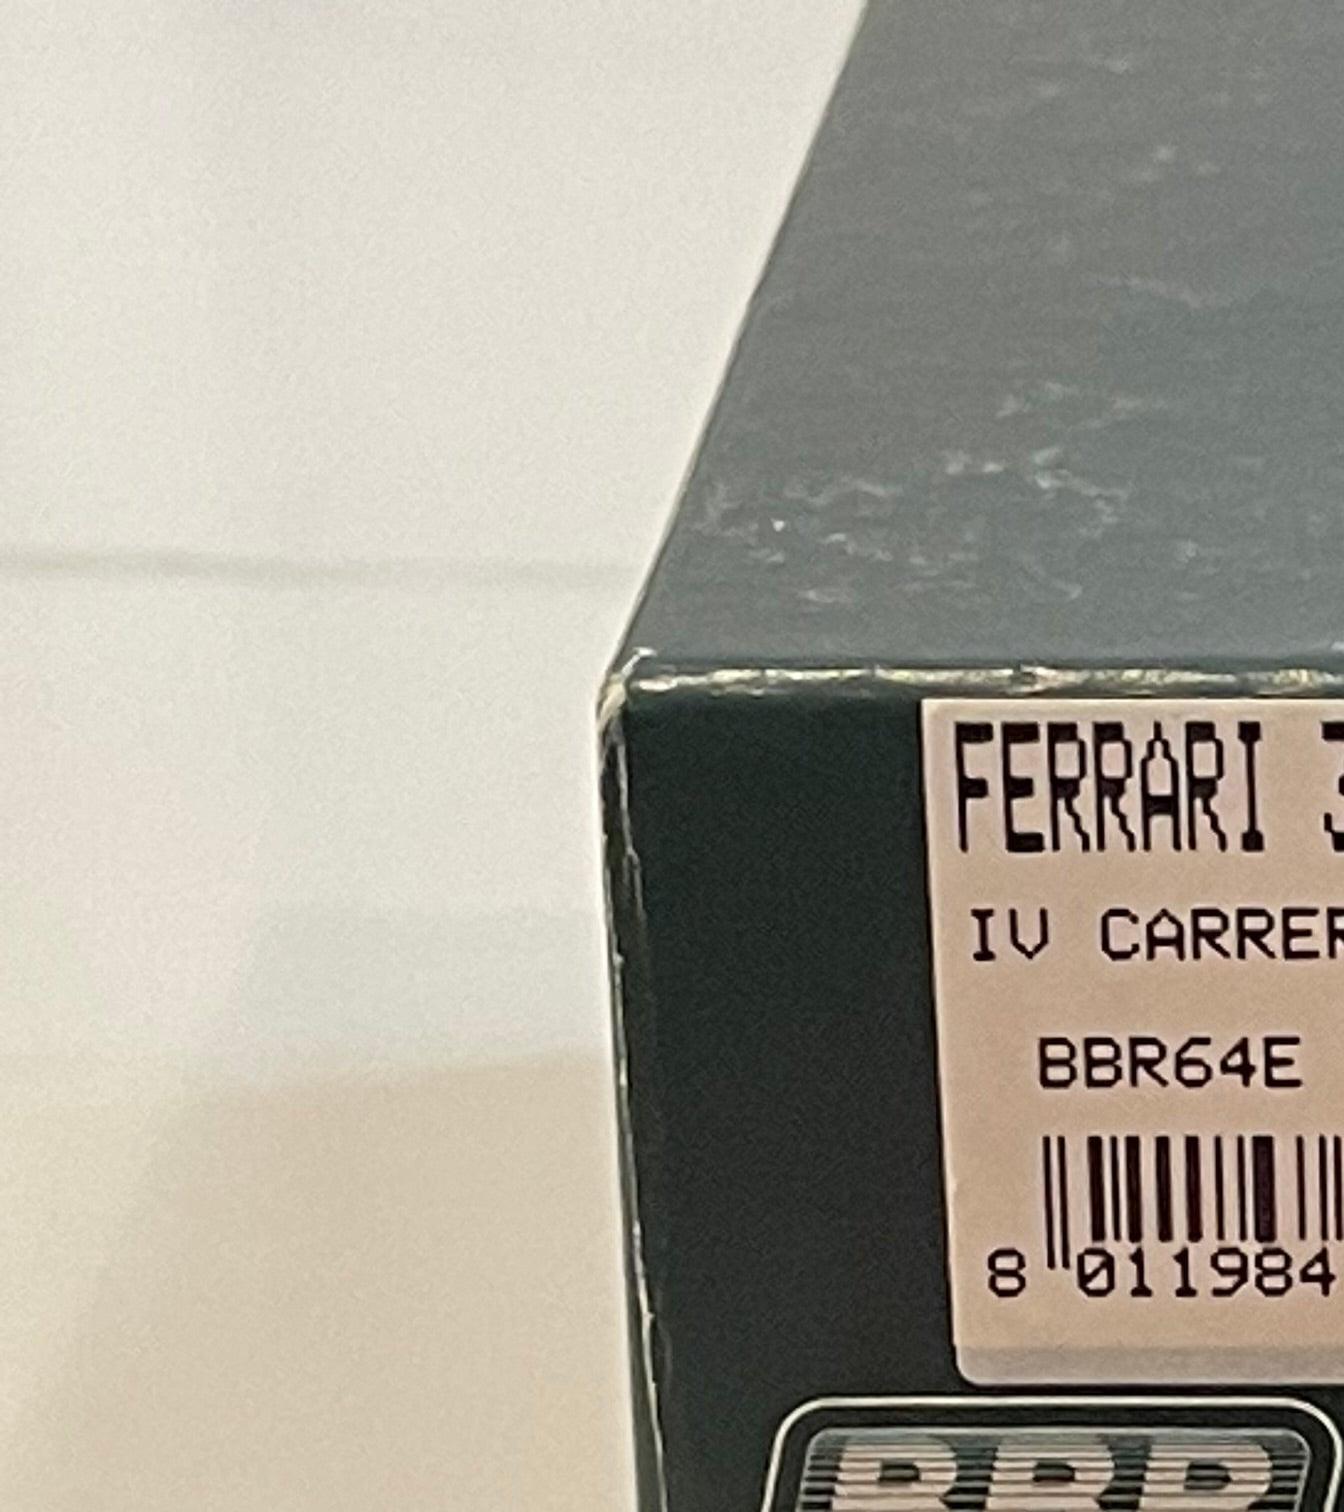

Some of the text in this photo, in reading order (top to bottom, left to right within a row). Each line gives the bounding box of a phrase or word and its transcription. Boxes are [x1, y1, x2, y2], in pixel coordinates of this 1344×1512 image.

[954, 720, 1265, 853] FERRARI
[970, 907, 1049, 961] IV
[1038, 1036, 1303, 1088] BBR64E
[987, 1247, 1026, 1297] 8
[1077, 1246, 1336, 1297] 011984
